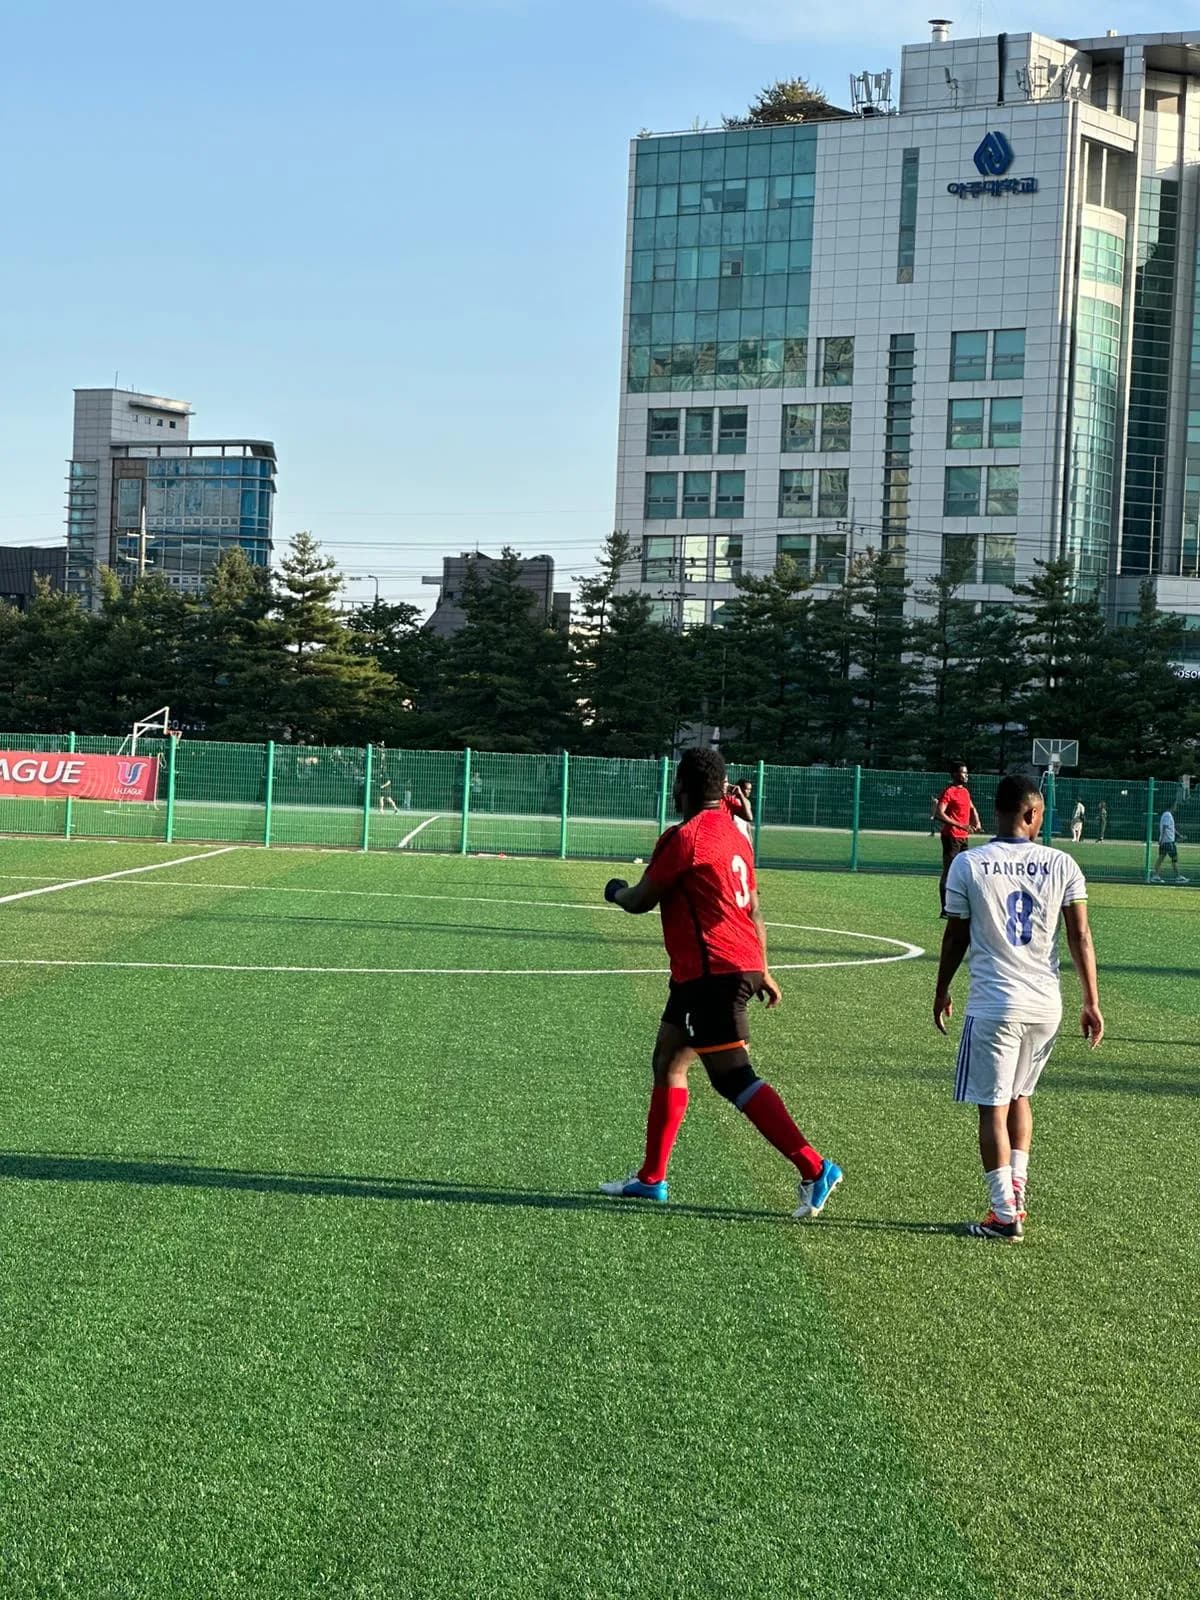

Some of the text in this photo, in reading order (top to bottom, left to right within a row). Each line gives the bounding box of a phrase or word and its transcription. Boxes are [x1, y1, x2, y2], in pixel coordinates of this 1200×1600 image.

[946, 177, 1039, 200] 아주대학교
[731, 854, 750, 909] 3
[1006, 890, 1034, 946] 8
